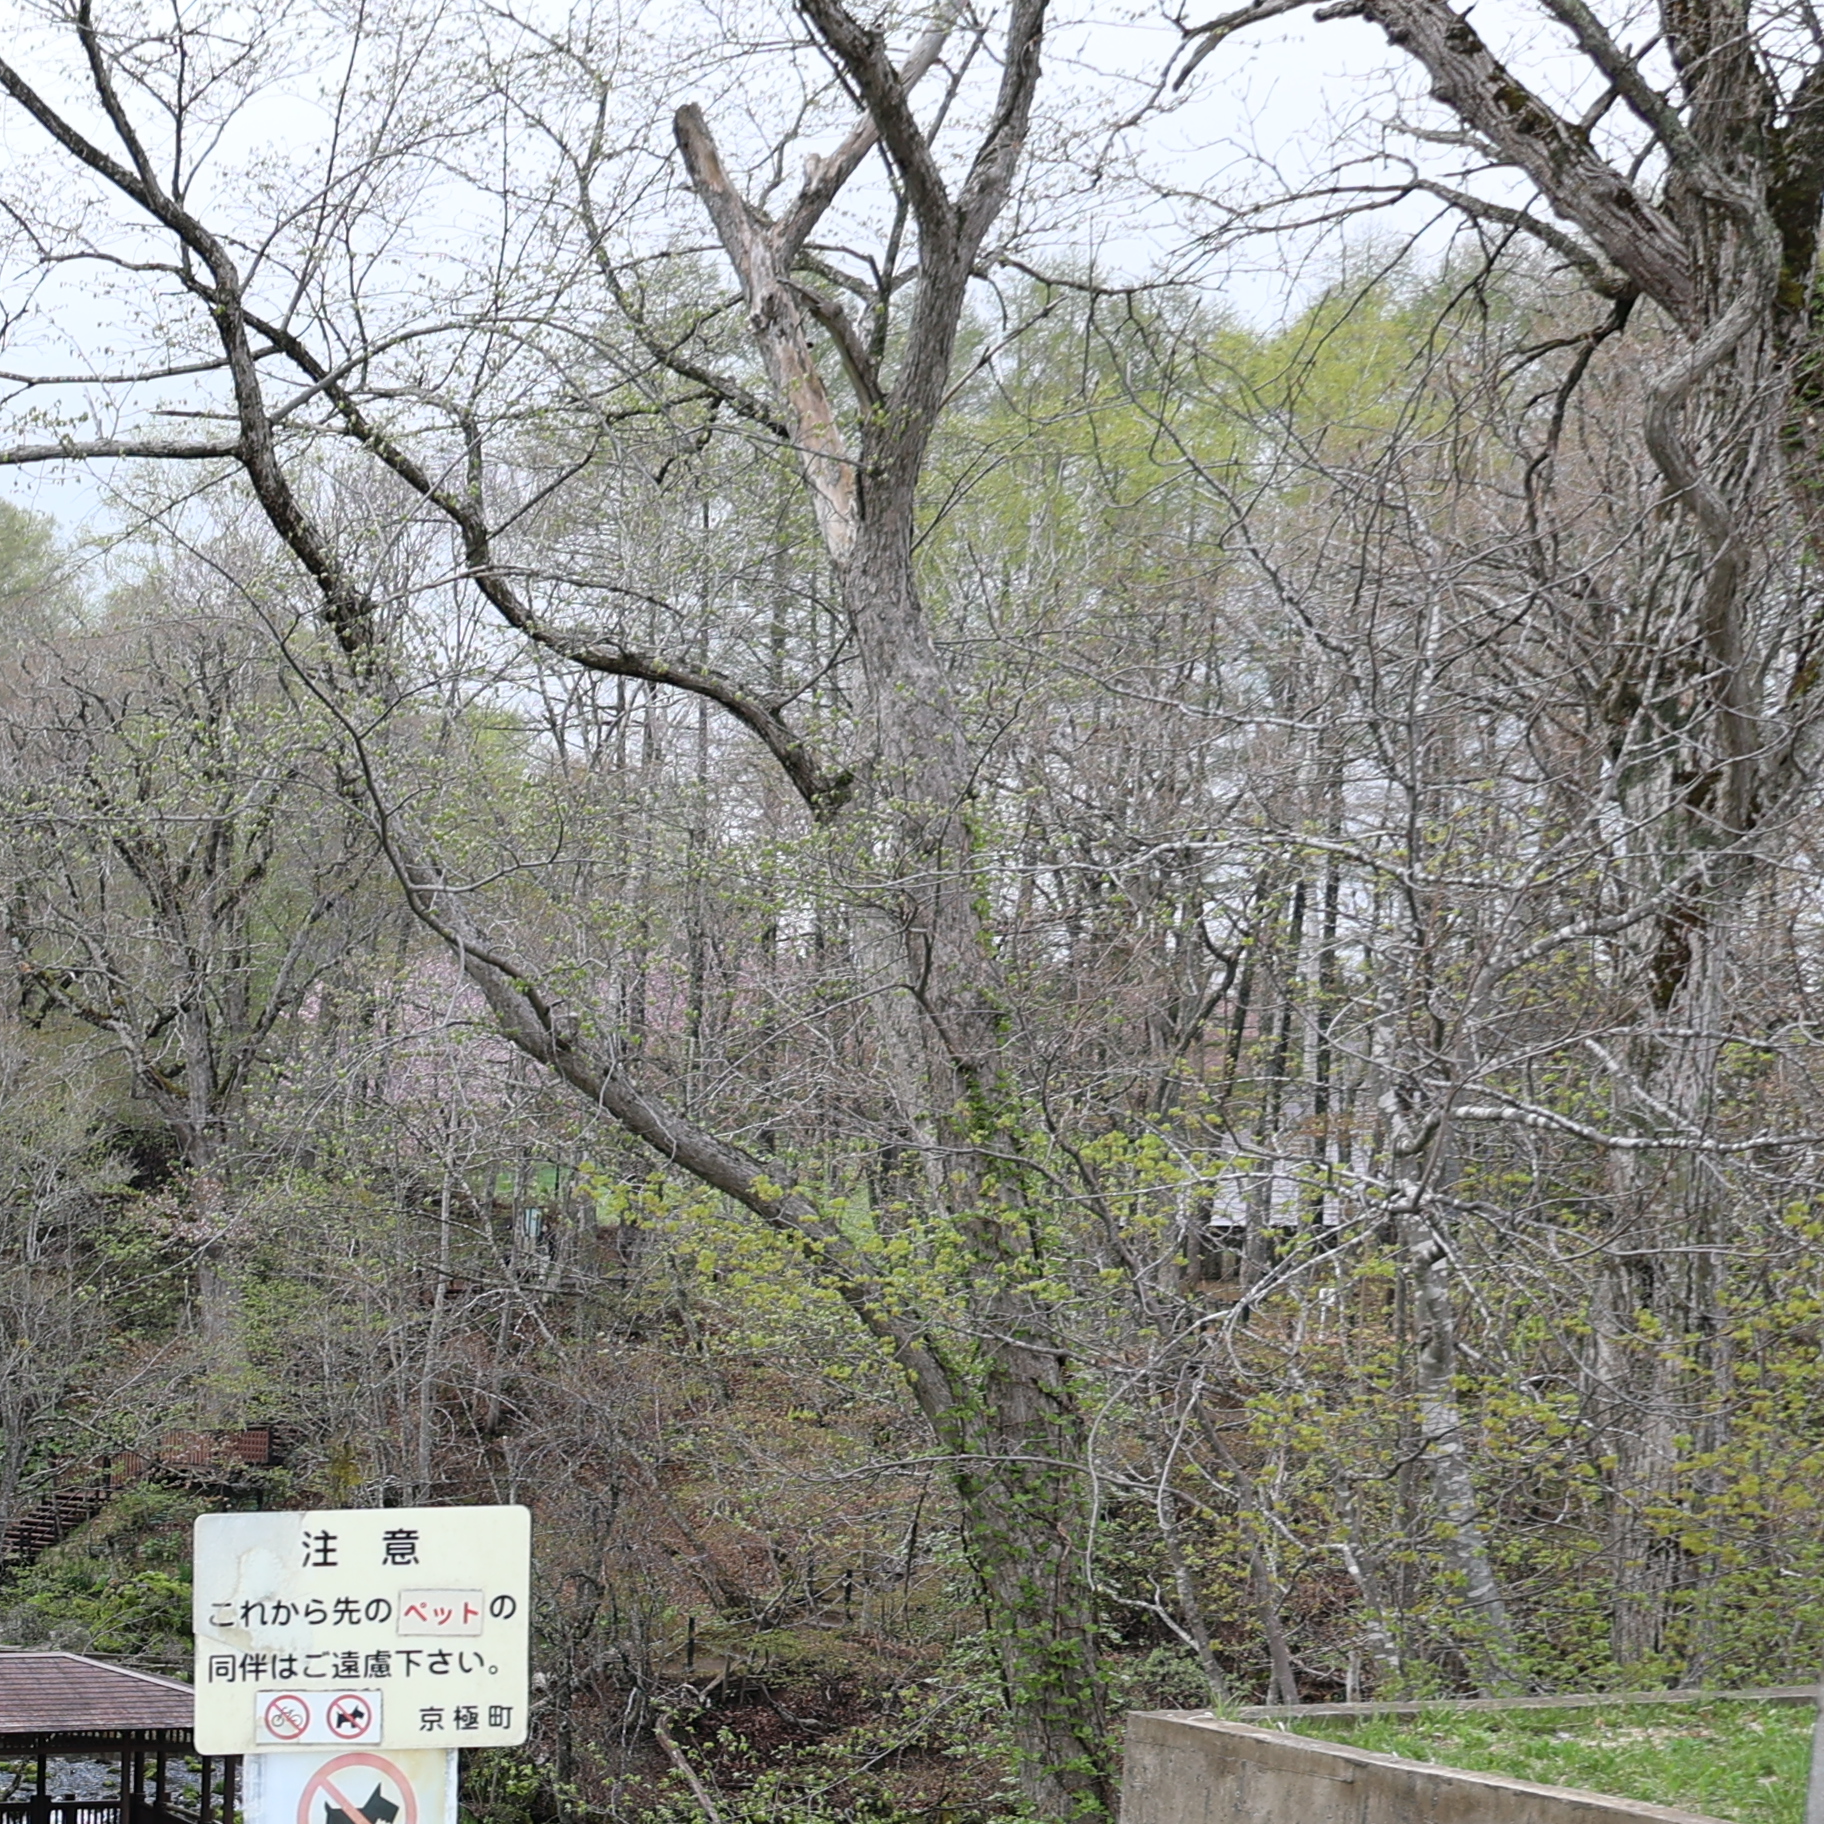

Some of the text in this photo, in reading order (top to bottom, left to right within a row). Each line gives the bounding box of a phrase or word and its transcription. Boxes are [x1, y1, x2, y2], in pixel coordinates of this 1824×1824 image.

[208, 1648, 499, 1683] 同伴はご遠慮下さい。
[418, 1704, 514, 1732] 京極町
